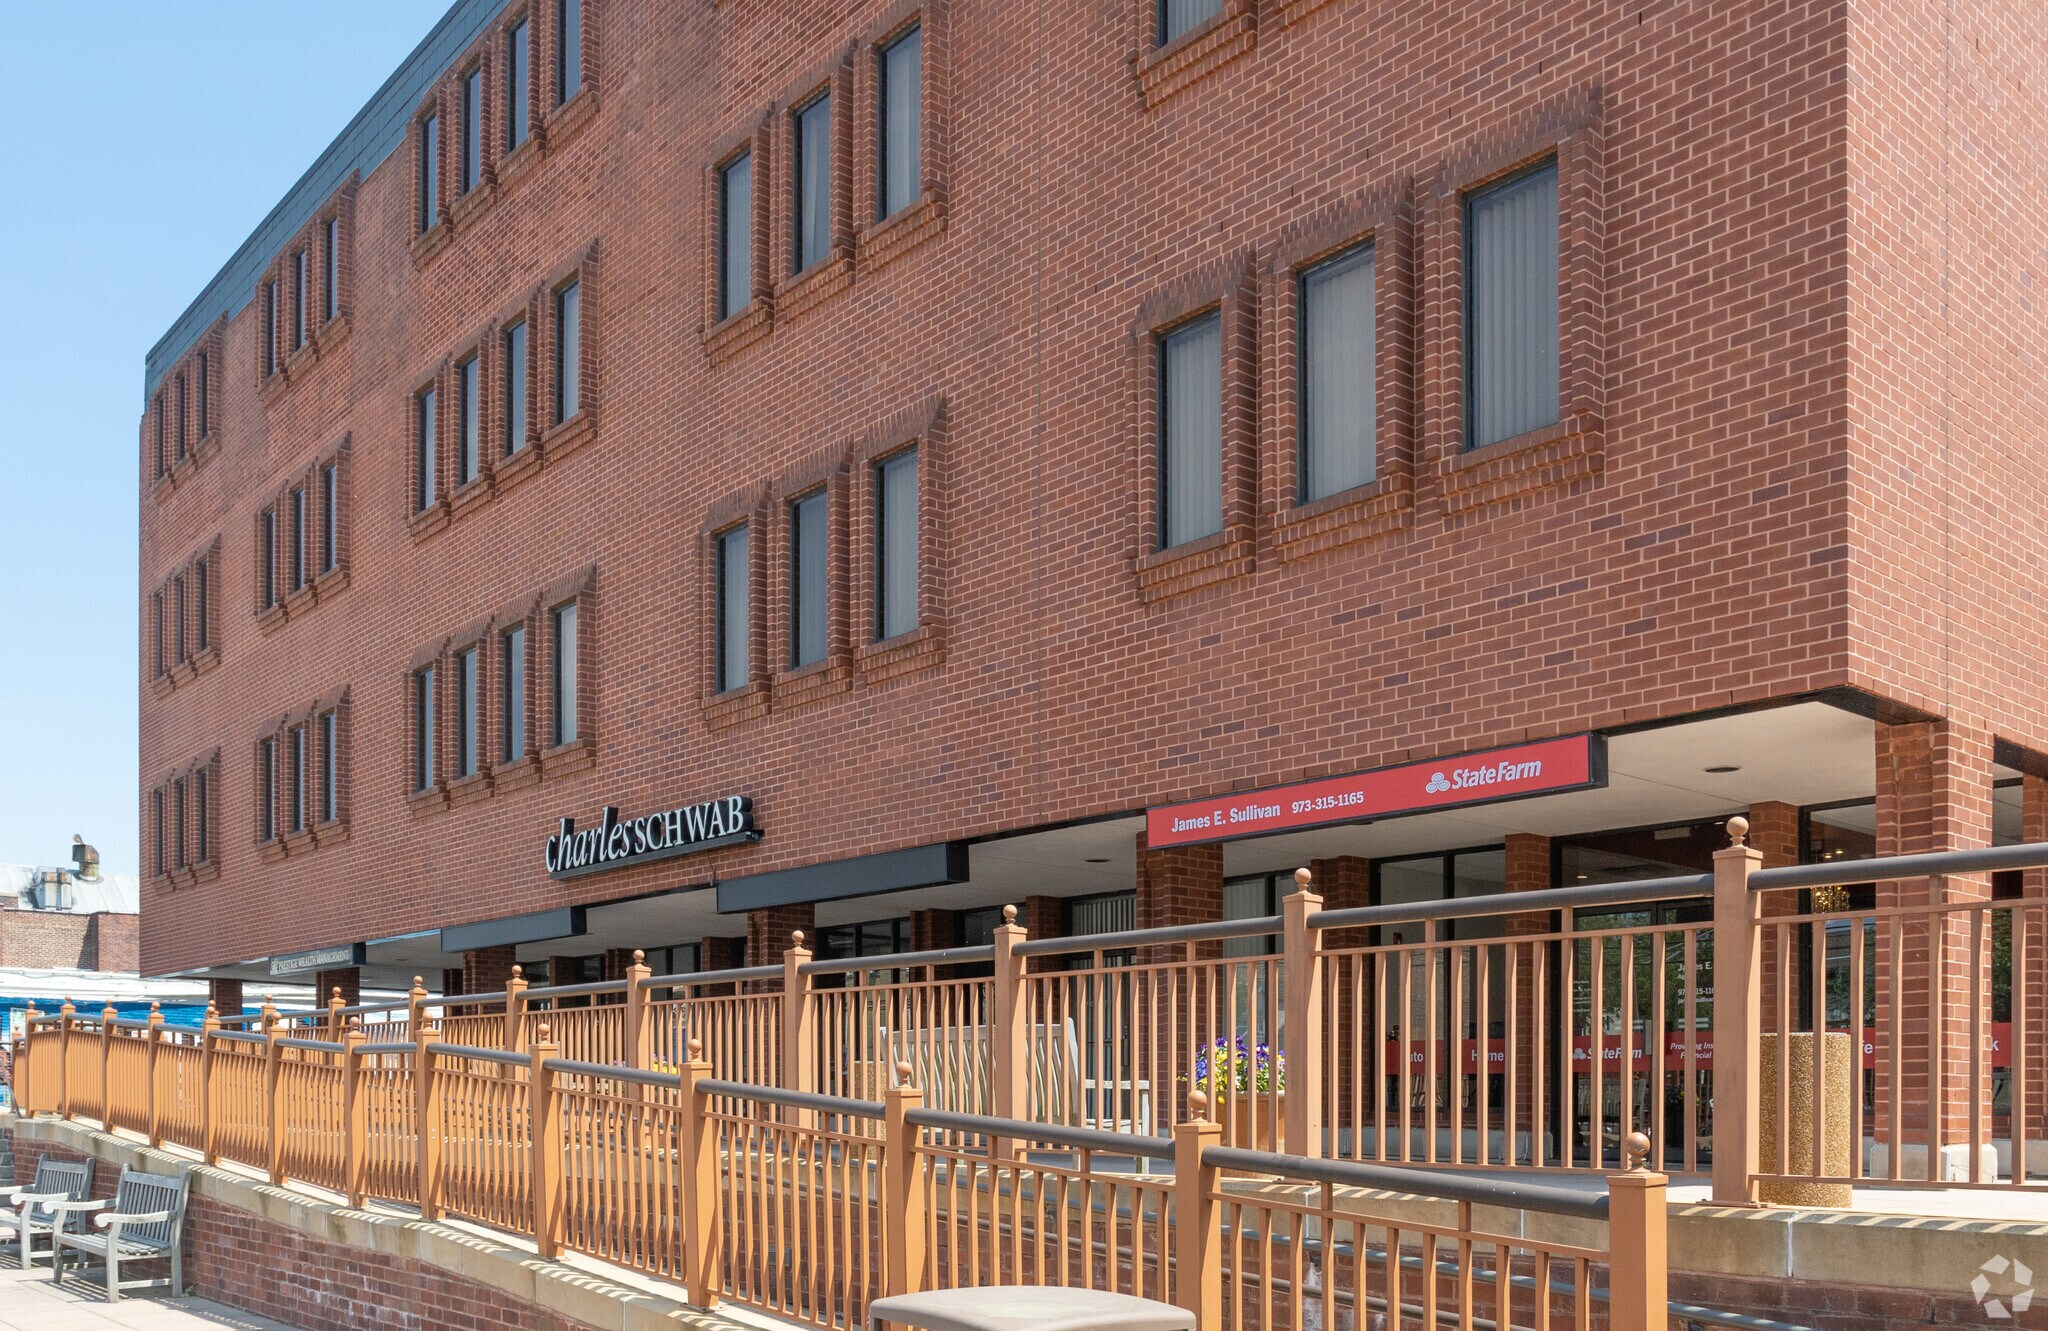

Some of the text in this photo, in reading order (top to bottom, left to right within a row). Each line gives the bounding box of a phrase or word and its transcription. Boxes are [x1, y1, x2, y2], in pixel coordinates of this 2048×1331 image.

[1291, 791, 1365, 815] 973-315-1165
[1171, 801, 1282, 834] James E. Sullivan
[1705, 961, 1713, 970] E.
[1471, 1049, 1505, 1062] Hme
